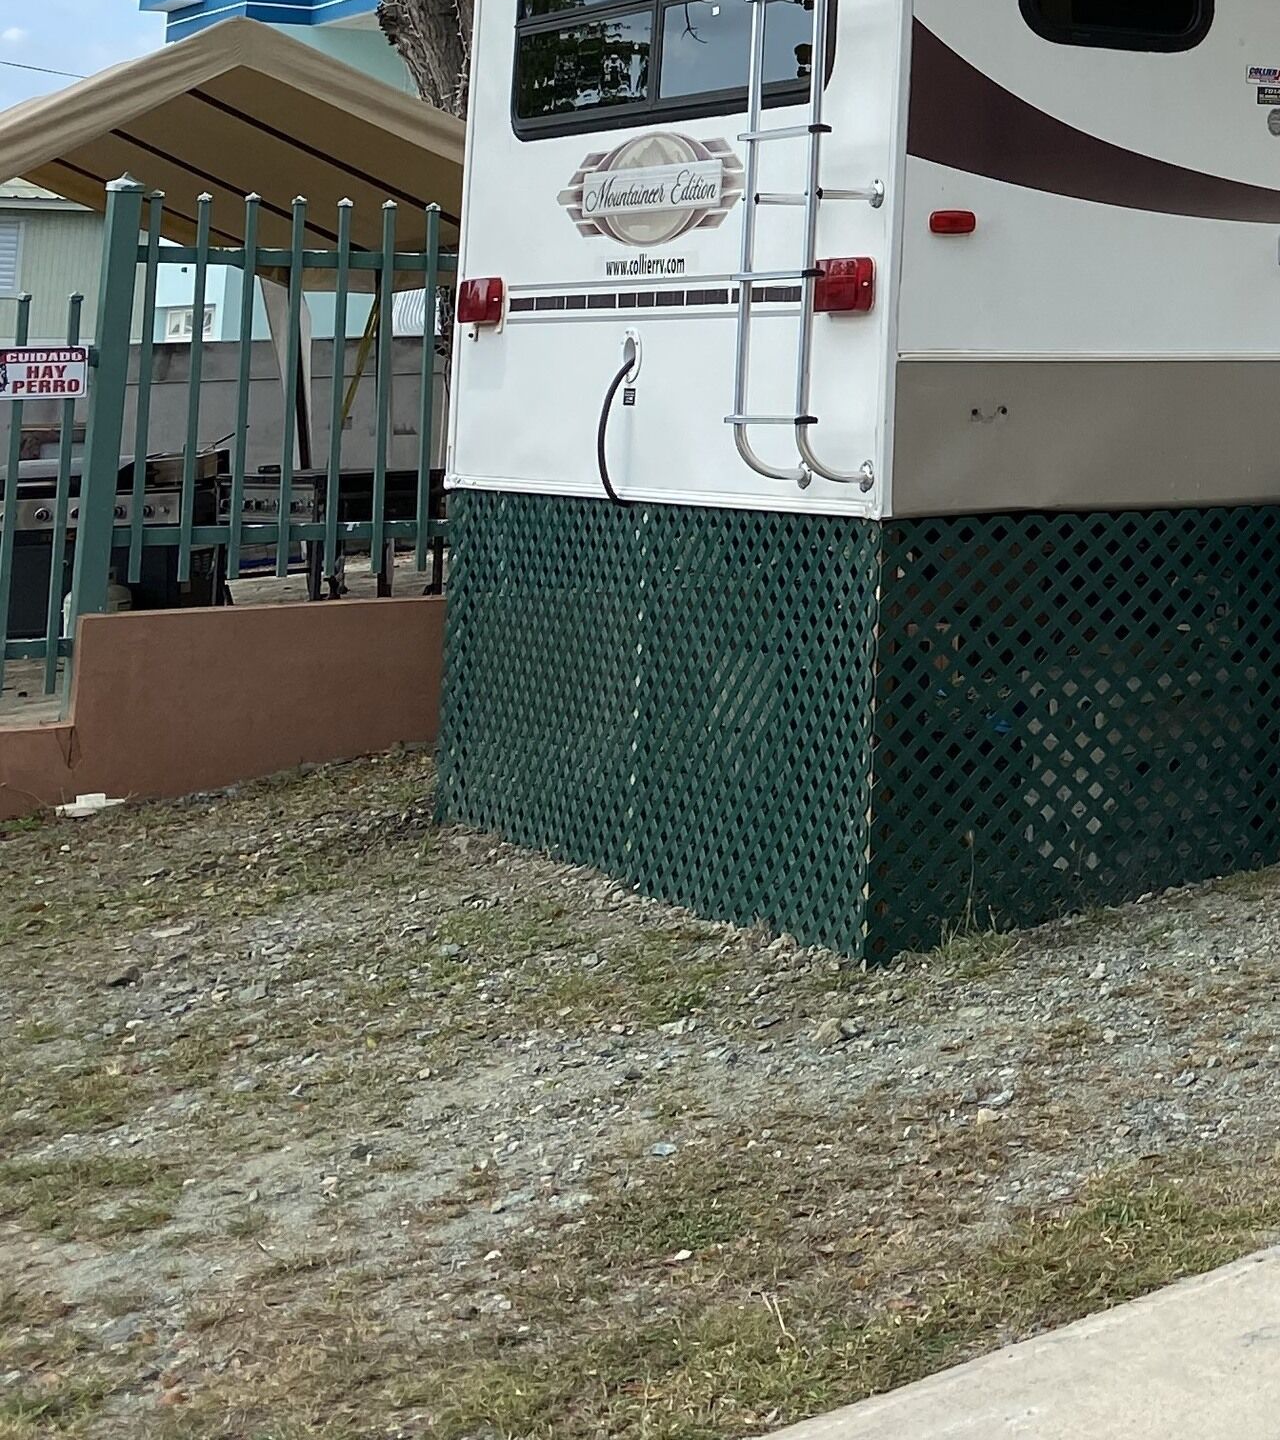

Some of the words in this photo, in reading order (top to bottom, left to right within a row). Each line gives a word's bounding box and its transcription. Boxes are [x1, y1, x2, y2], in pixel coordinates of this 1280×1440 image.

[585, 175, 665, 212] Mountaineer
[670, 169, 717, 205] Edition
[606, 253, 685, 276] www.collierrv.com
[6, 352, 83, 362] CUIDADO
[26, 365, 67, 378] HAY
[12, 379, 80, 394] PERRO
